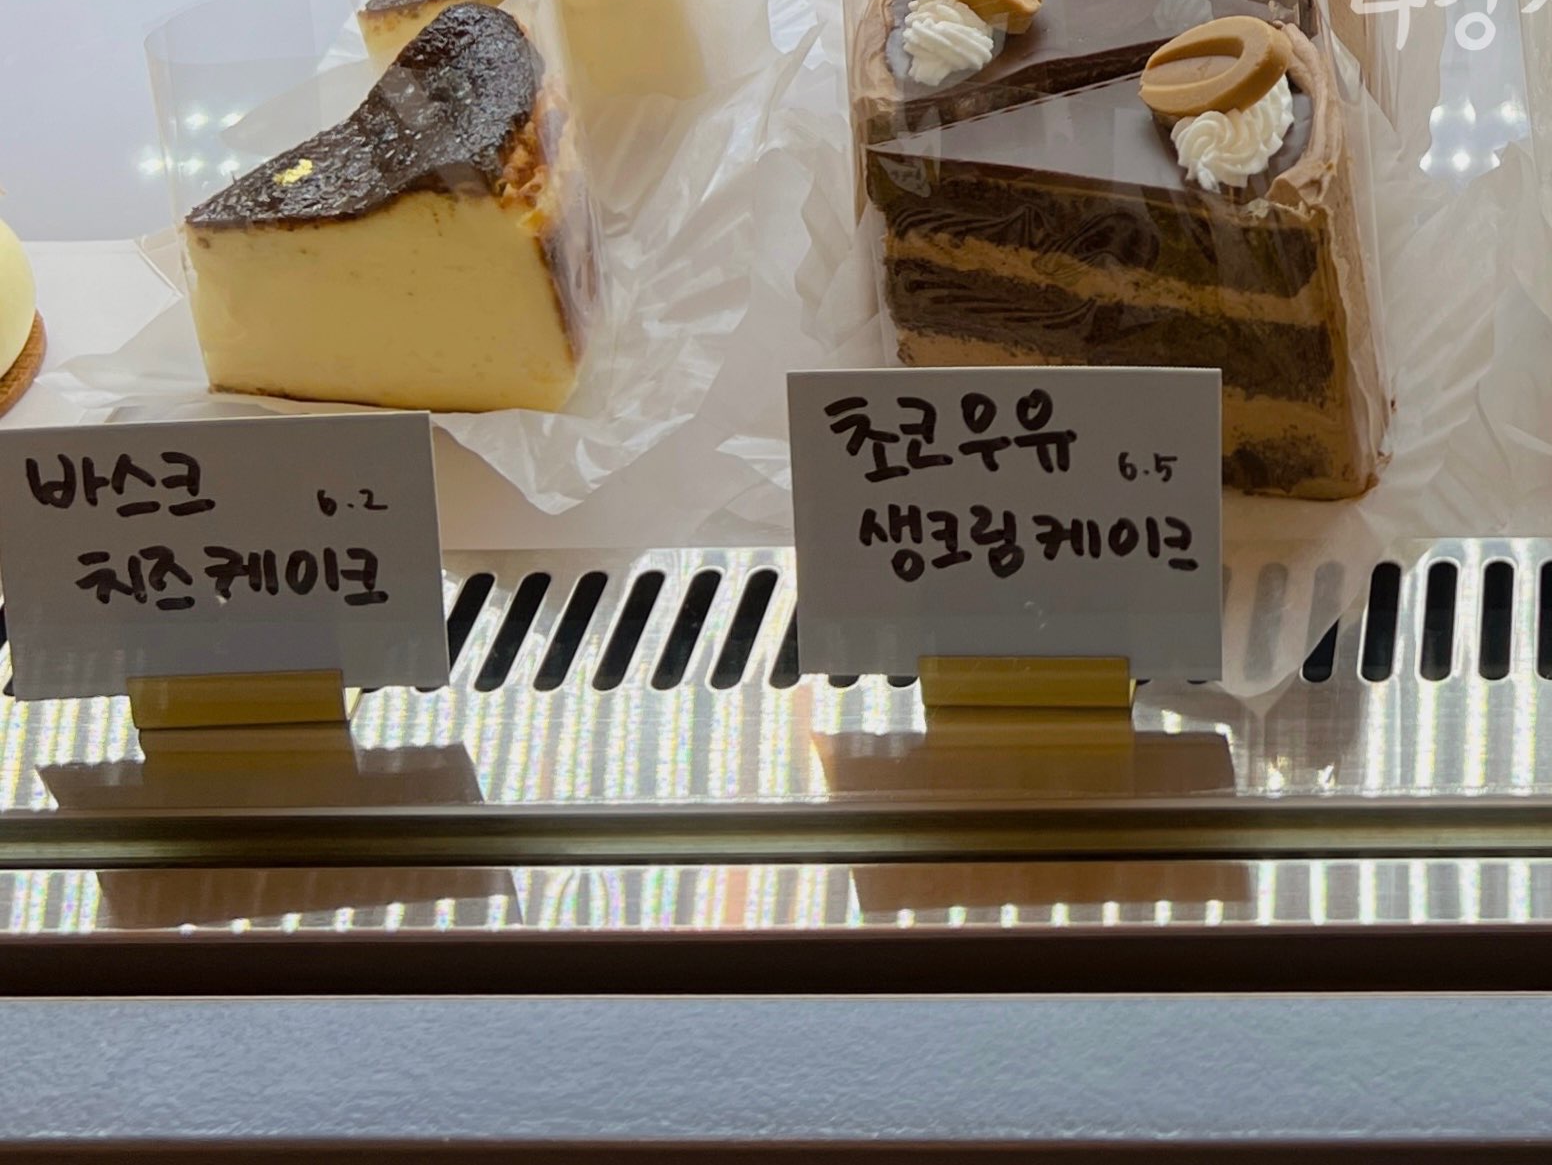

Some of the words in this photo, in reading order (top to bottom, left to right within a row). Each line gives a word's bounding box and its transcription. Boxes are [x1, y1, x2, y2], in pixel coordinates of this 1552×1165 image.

[823, 388, 1078, 484] 초코우유
[1117, 450, 1179, 483] 6.5
[25, 451, 216, 518] 바스크
[316, 488, 389, 517] 6.2
